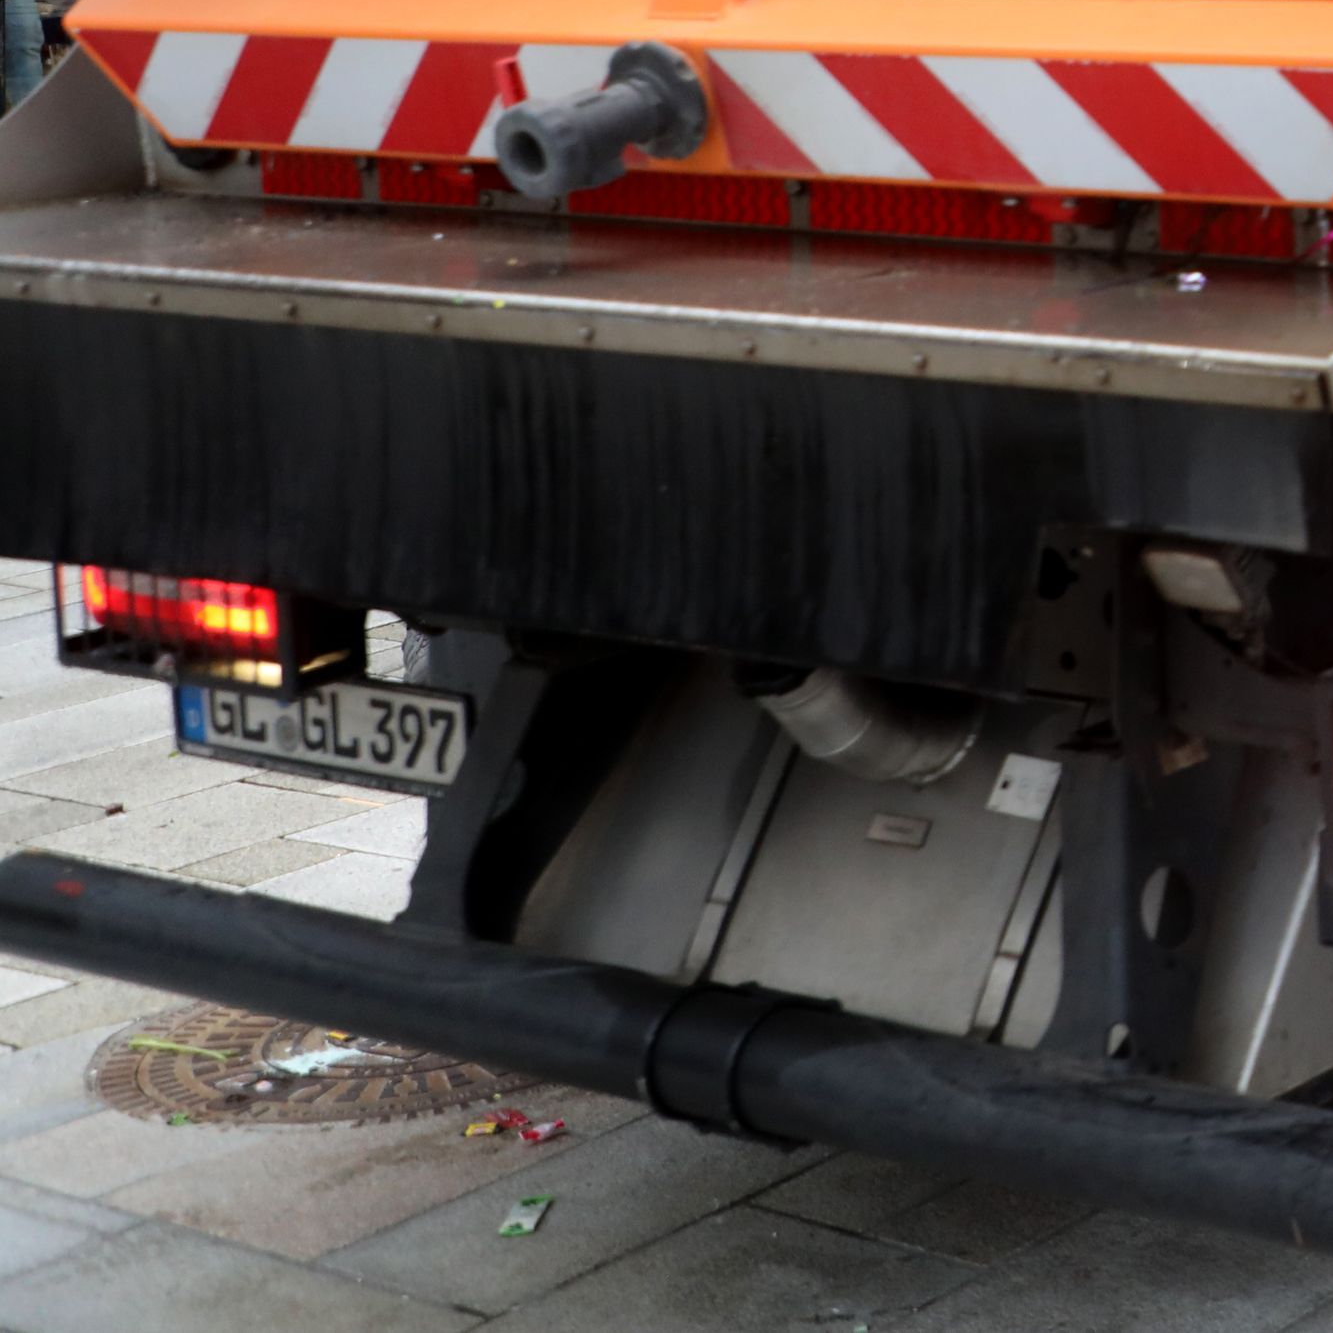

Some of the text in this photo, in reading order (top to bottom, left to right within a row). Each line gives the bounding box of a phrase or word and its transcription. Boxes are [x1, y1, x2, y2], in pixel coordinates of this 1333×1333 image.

[209, 686, 267, 743] GL
[301, 690, 359, 759] GL
[369, 697, 457, 775] 397
